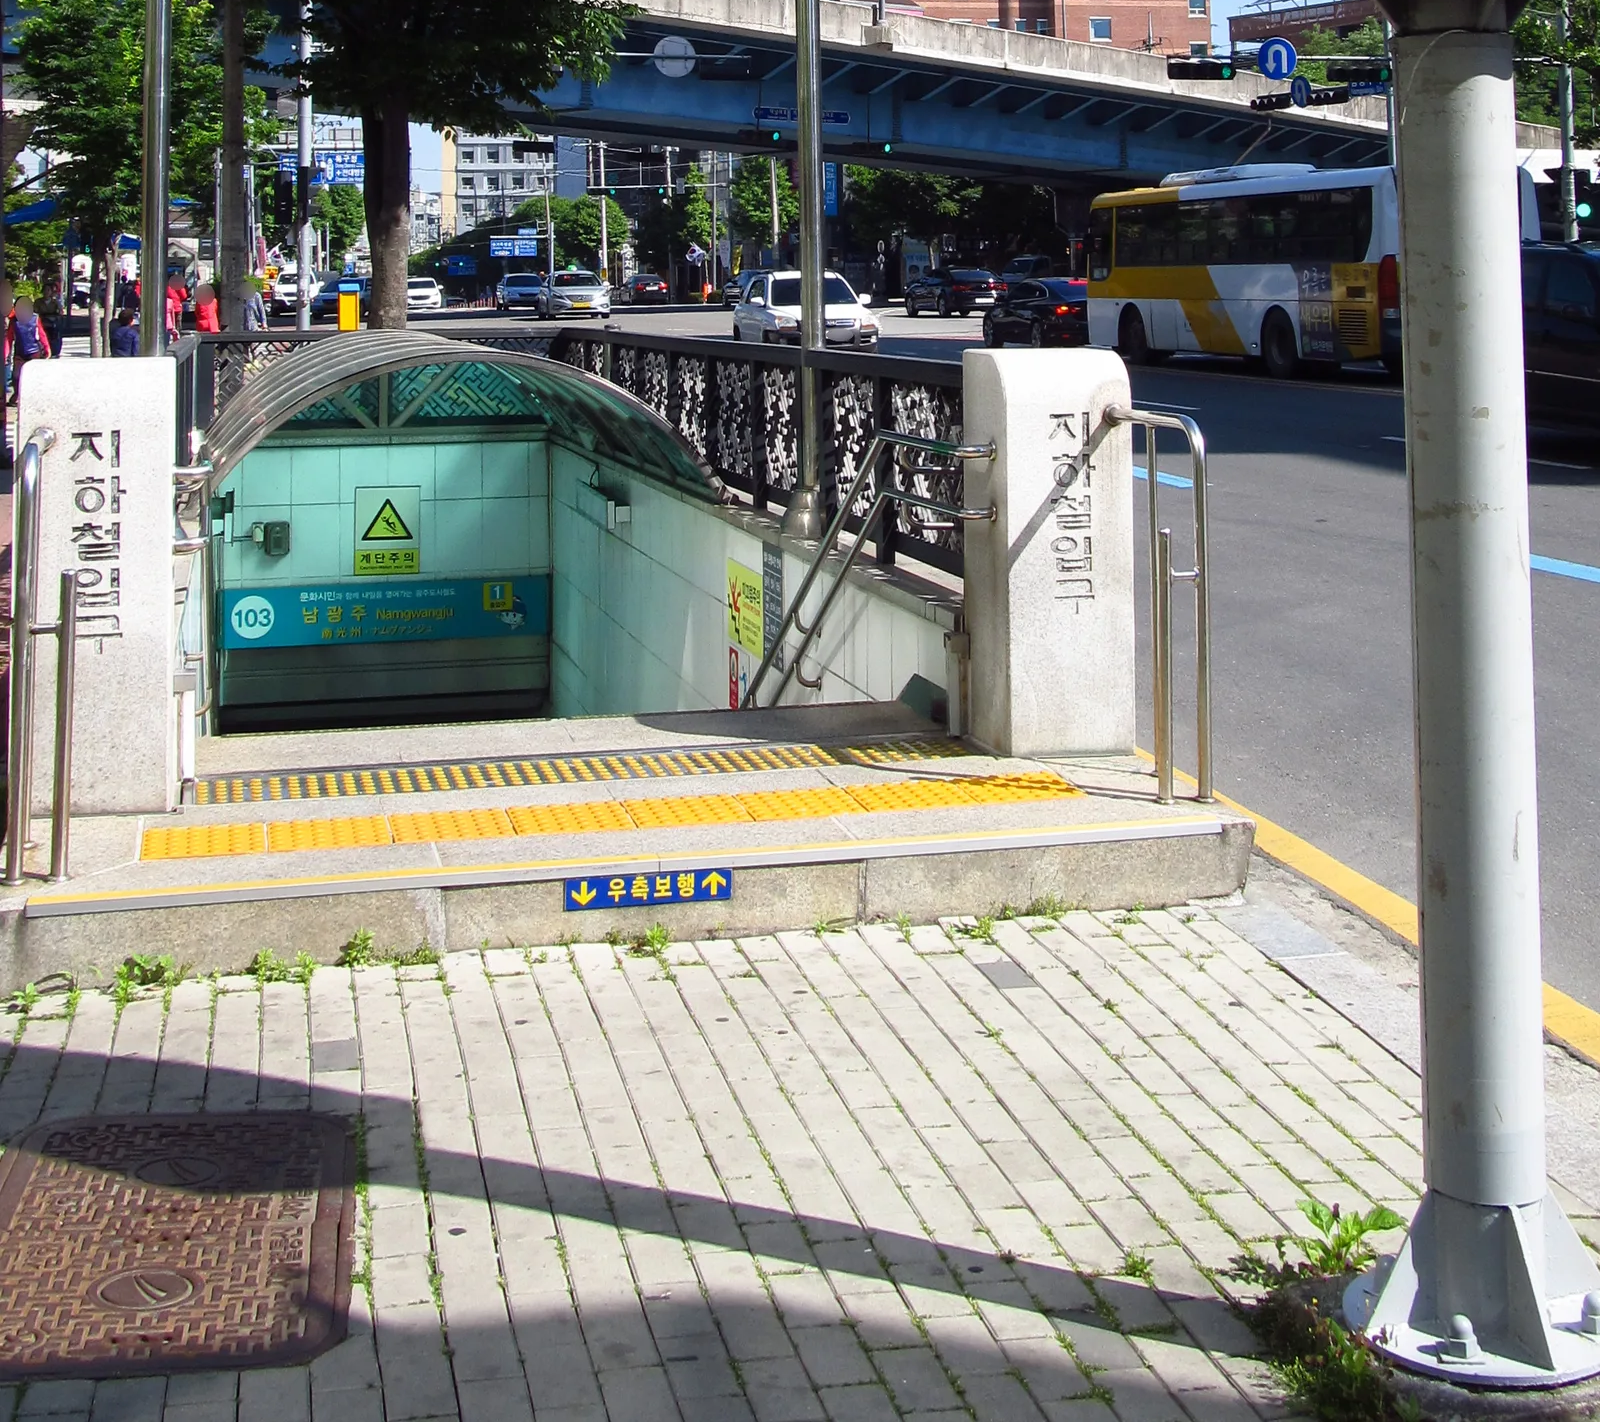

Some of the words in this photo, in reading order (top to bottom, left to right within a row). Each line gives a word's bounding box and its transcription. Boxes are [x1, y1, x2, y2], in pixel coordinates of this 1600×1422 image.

[1048, 412, 1096, 615] 지하철입구
[69, 429, 127, 655] 지하철입구
[360, 552, 414, 564] 계단주의
[299, 591, 343, 603] 문화시민과
[492, 585, 500, 599] 1
[234, 607, 272, 628] 103
[302, 604, 367, 624] 남광주
[376, 604, 455, 623] Namgwangju
[608, 872, 695, 903] 우측보행
